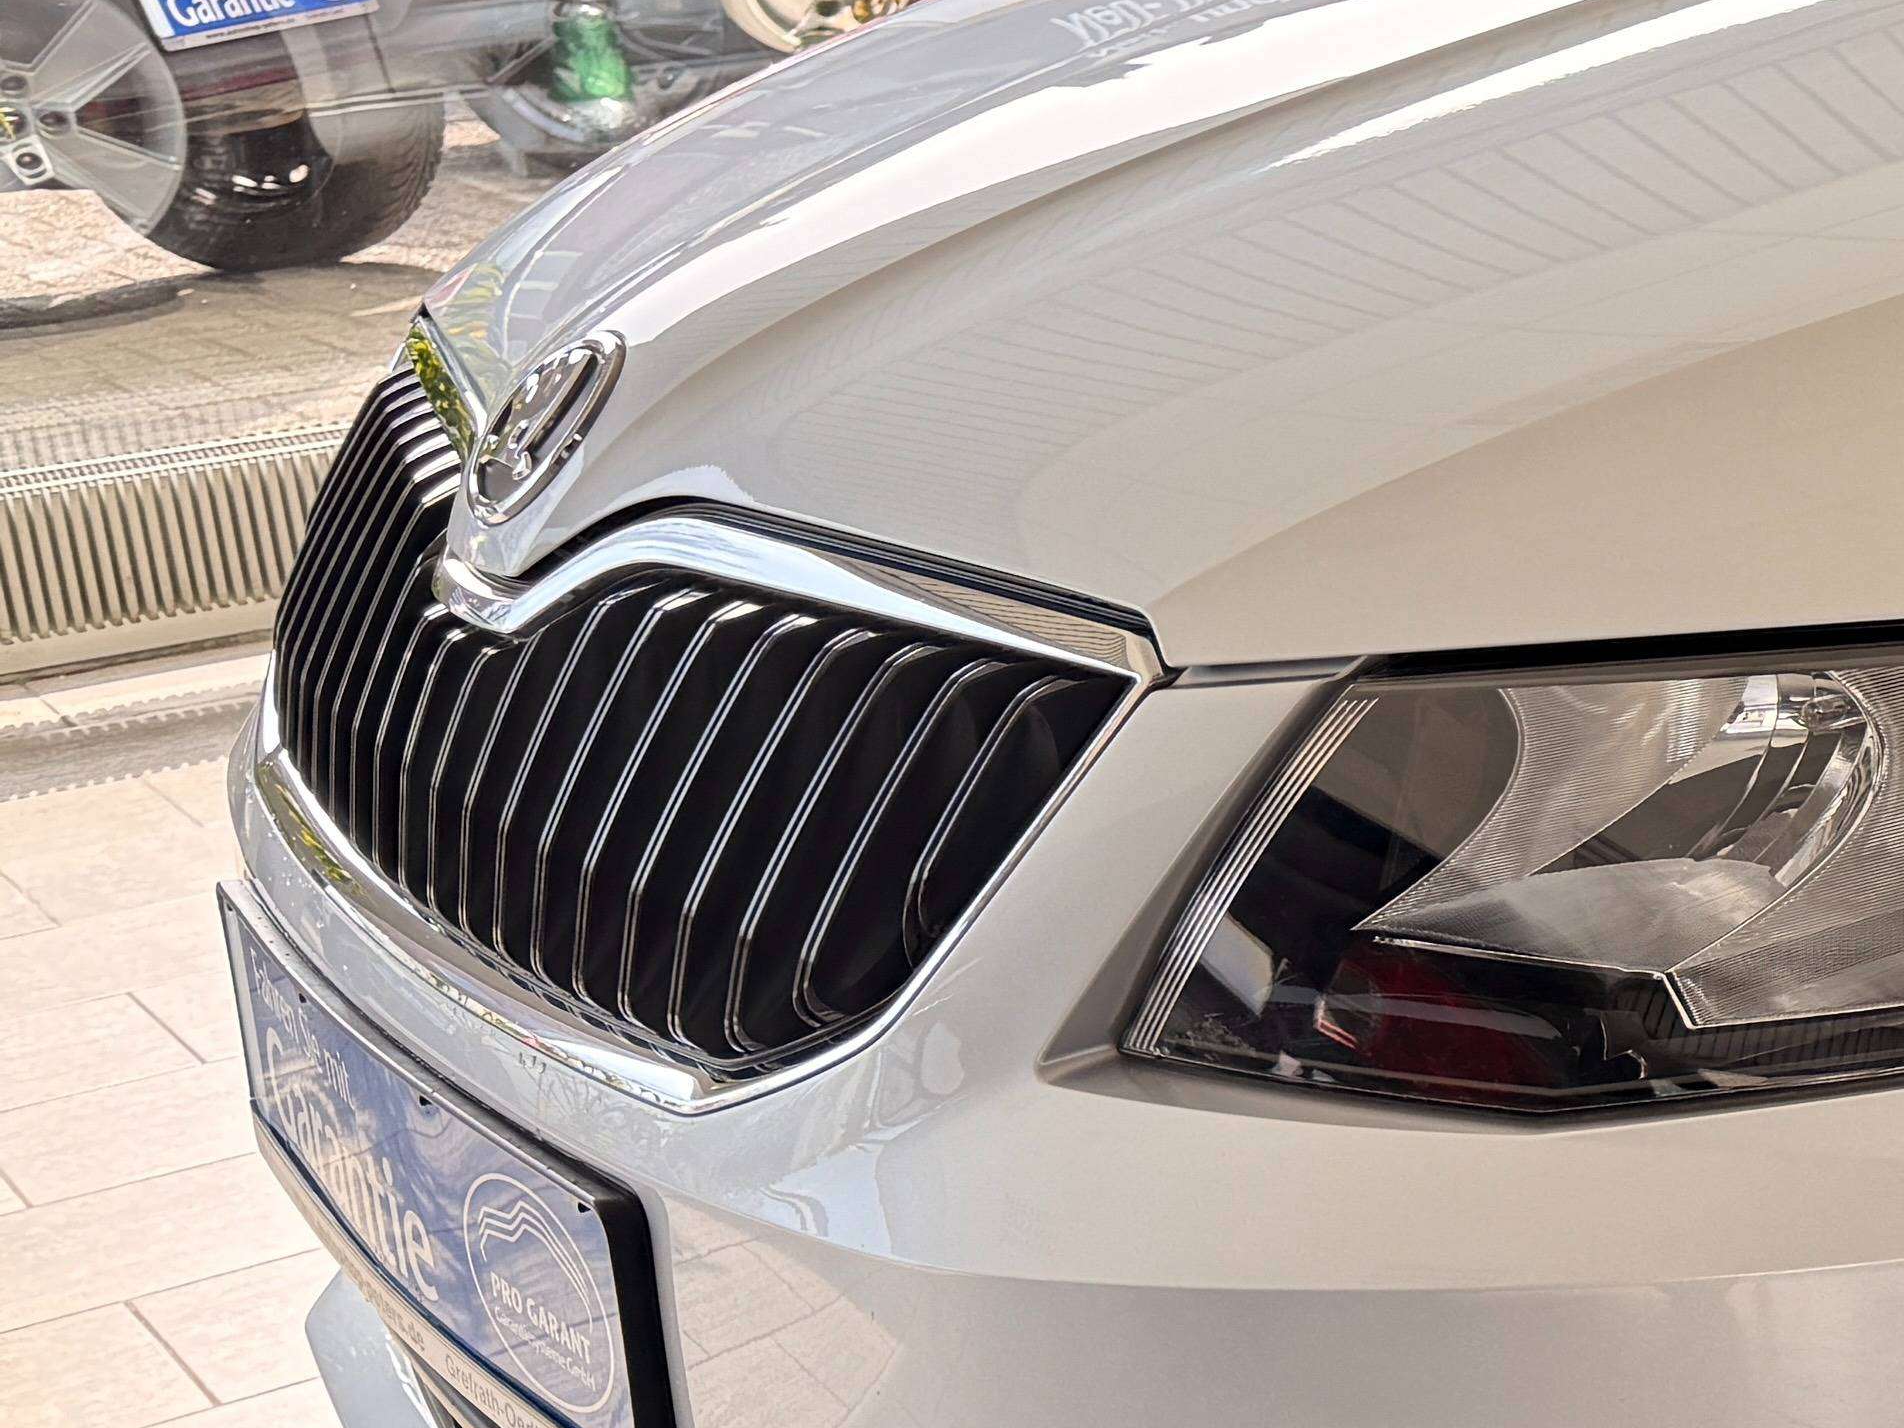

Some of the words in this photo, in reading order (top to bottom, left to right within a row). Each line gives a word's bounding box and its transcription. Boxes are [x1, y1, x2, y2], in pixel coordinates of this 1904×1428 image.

[249, 947, 301, 1044] Fahren
[298, 1008, 323, 1073] Sie
[323, 1047, 357, 1112] mit
[266, 1026, 440, 1302] Garantie
[490, 1270, 523, 1315] PRO
[526, 1297, 590, 1365] GARANT
